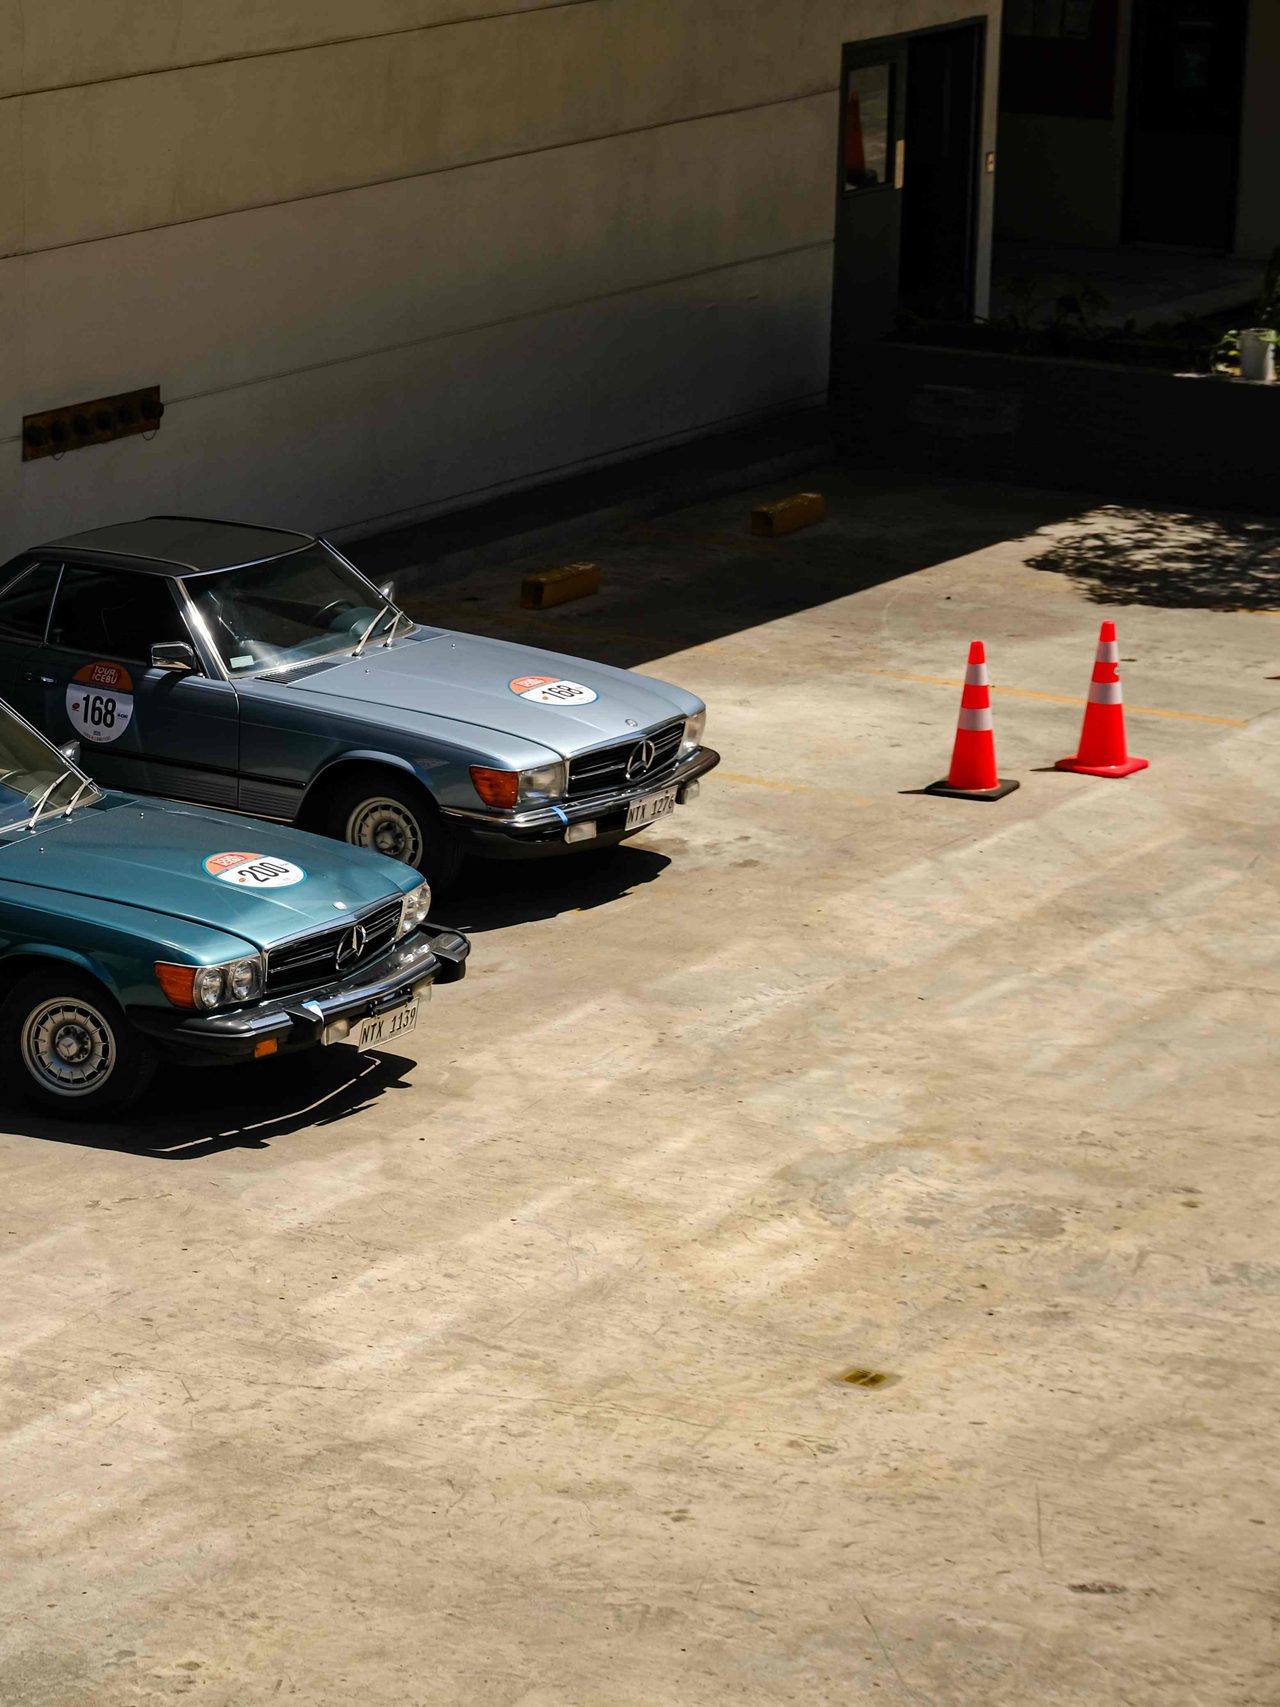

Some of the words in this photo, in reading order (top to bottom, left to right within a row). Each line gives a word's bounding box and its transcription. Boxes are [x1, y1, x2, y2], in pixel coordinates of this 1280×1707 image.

[94, 666, 117, 676] TOUR
[541, 684, 584, 700] 168
[82, 694, 117, 728] 168
[628, 803, 648, 824] NTX
[237, 862, 290, 883] 200
[361, 1019, 385, 1045] NTX
[389, 1006, 416, 1034] 1139
